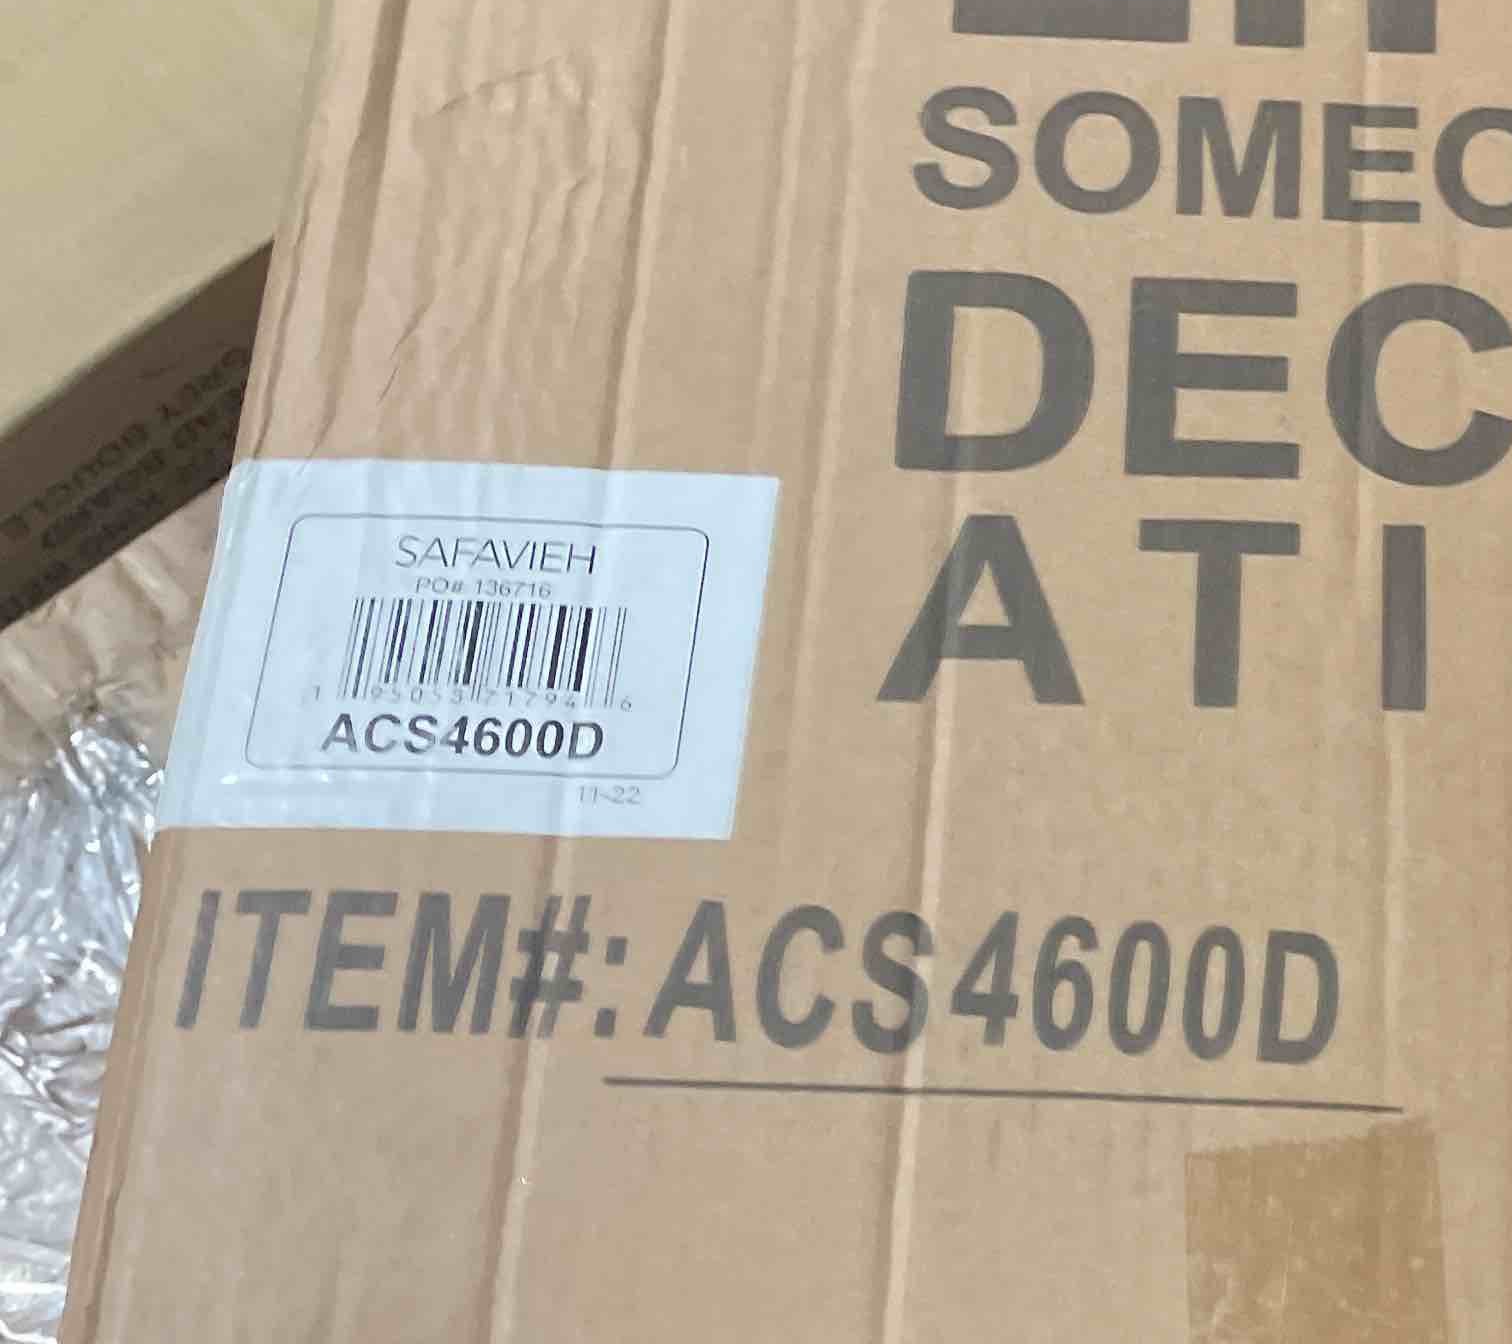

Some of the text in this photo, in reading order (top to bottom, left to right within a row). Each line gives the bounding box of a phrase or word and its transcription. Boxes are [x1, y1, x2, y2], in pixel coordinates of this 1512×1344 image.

[395, 536, 597, 575] SAFAVIEH
[416, 576, 464, 594] PO#
[320, 712, 605, 761] ACS4600D
[643, 899, 1341, 1066] ACS4600D
